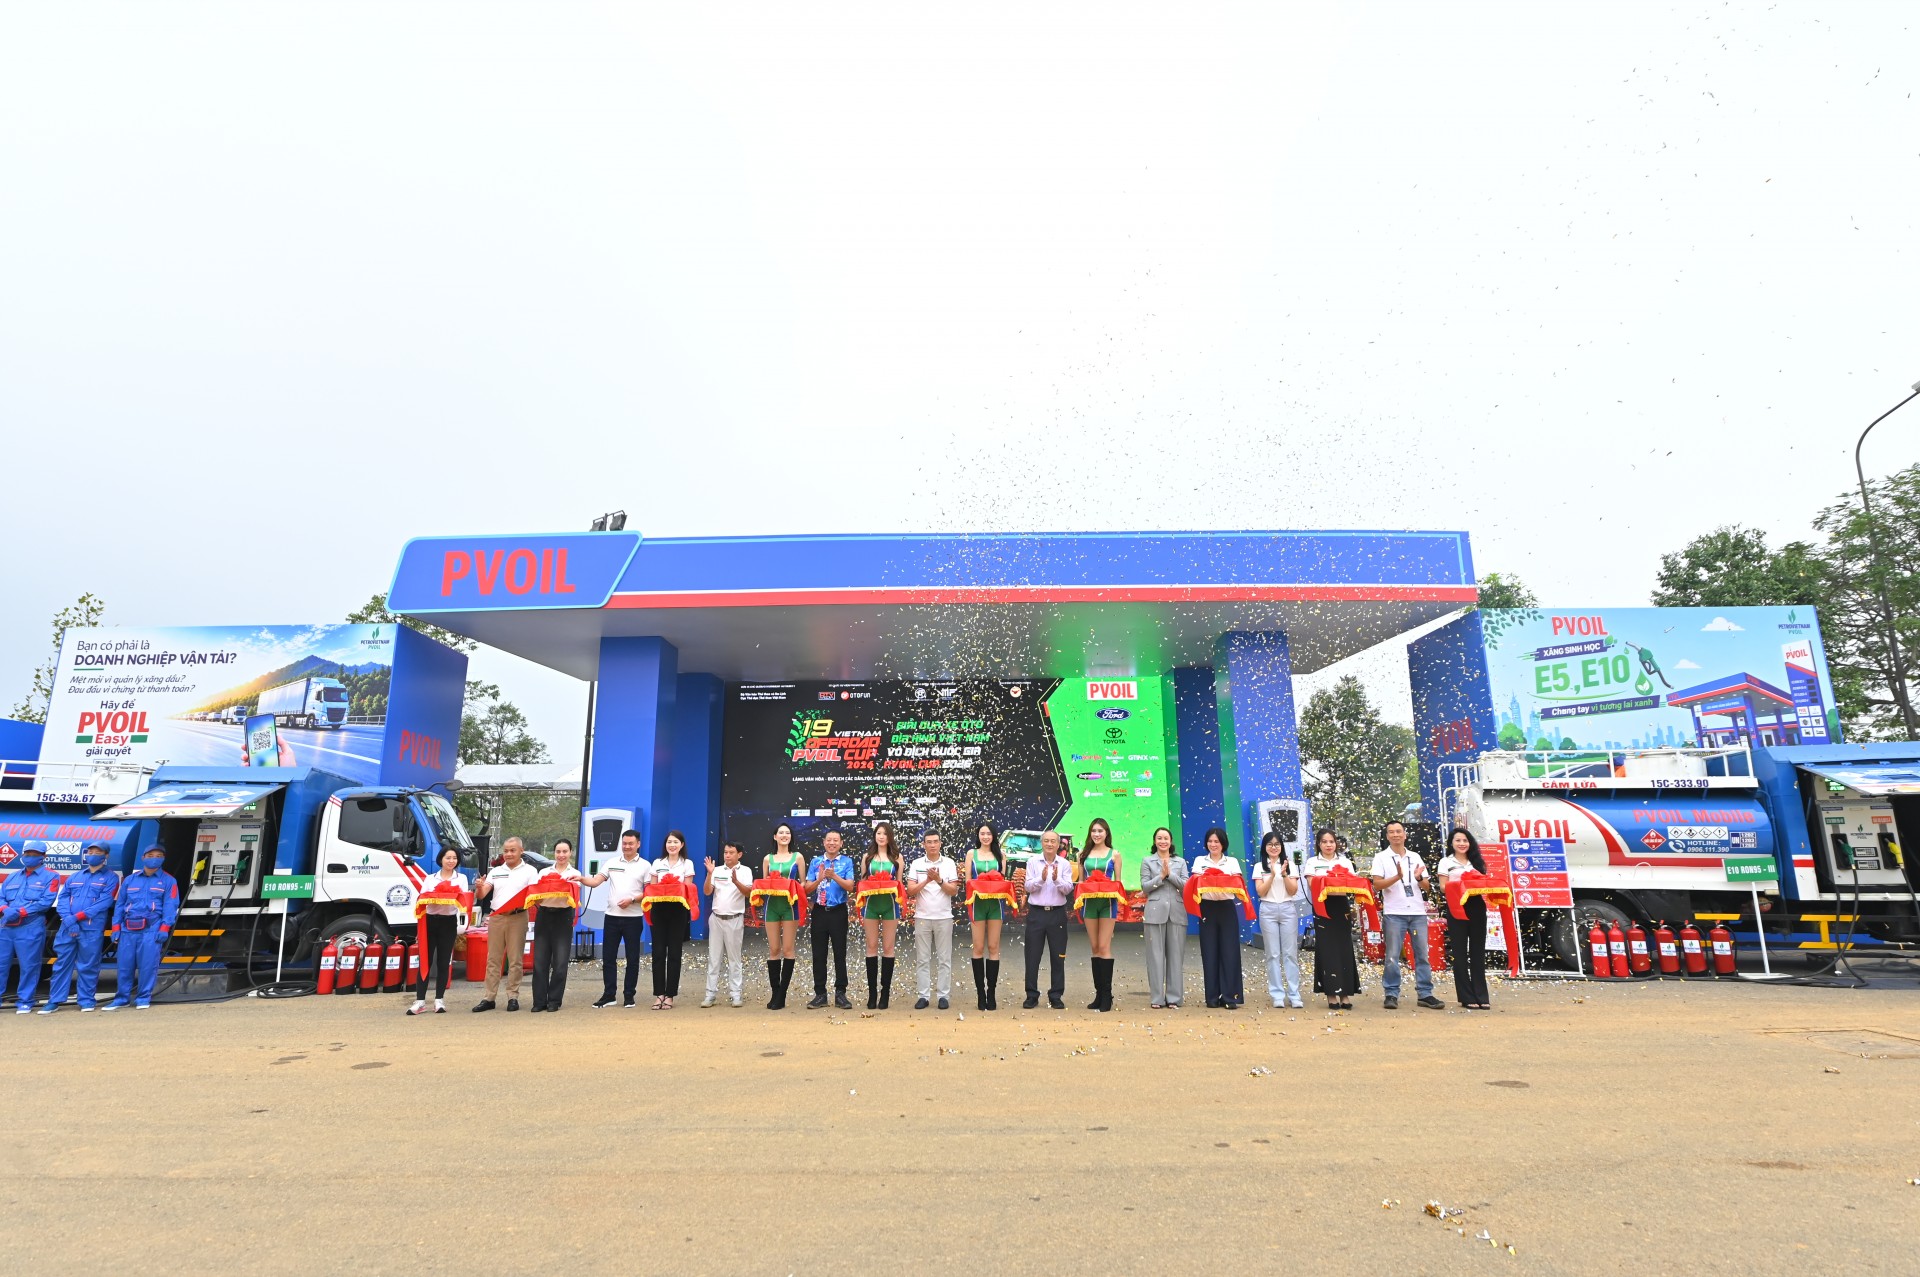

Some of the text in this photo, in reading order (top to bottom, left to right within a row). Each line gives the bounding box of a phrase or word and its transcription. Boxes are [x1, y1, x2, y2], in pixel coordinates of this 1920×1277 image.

[441, 548, 576, 597] PVOIL
[1551, 616, 1608, 636] PVOIL
[77, 640, 150, 652] Bạn có phải là
[1543, 642, 1601, 657] XĂNG SINH HỌC
[74, 650, 237, 667] DOANH NGHIỆP VẬN TẢI?
[1786, 649, 1808, 660] PVOIL
[70, 676, 86, 684] Mệt
[89, 675, 103, 683] mỏi
[113, 676, 133, 686] quản
[135, 675, 142, 686] lý
[144, 676, 163, 685] xăng
[165, 675, 186, 683] dầu?
[86, 685, 101, 693] đầu
[112, 685, 135, 695] chứng
[137, 685, 147, 693] từ
[1090, 683, 1134, 698] PVOIL
[100, 699, 136, 711] Hãy để
[1552, 707, 1576, 716] Chung
[1577, 705, 1590, 714] tay
[1600, 702, 1622, 712] tương
[1623, 701, 1633, 709] lai
[1634, 699, 1653, 707] xanh
[1102, 710, 1124, 719] Ford
[77, 711, 149, 733] PVOIL
[803, 719, 834, 737] 19
[95, 734, 129, 746] Easy
[805, 737, 881, 748] OFFROAD
[1430, 717, 1478, 756] PVOIL
[86, 746, 131, 757] giải quyết
[399, 729, 442, 770] PVOIL
[792, 749, 877, 762] PVOIL CUP
[846, 761, 874, 769] 2026
[883, 760, 915, 769] PVOIL
[1542, 779, 1597, 789] CẤM LỬA
[1650, 779, 1709, 788] 15C-333.90
[37, 793, 95, 803] 15C-334.67
[1632, 809, 1756, 823] PVOIL Mobile
[55, 824, 116, 841] Mobile
[1497, 819, 1576, 843] PVOIL
[1727, 866, 1740, 874] E10
[1740, 865, 1762, 874] RON95
[264, 883, 277, 891] E10
[278, 882, 298, 891] RON95
[304, 882, 312, 890] III
